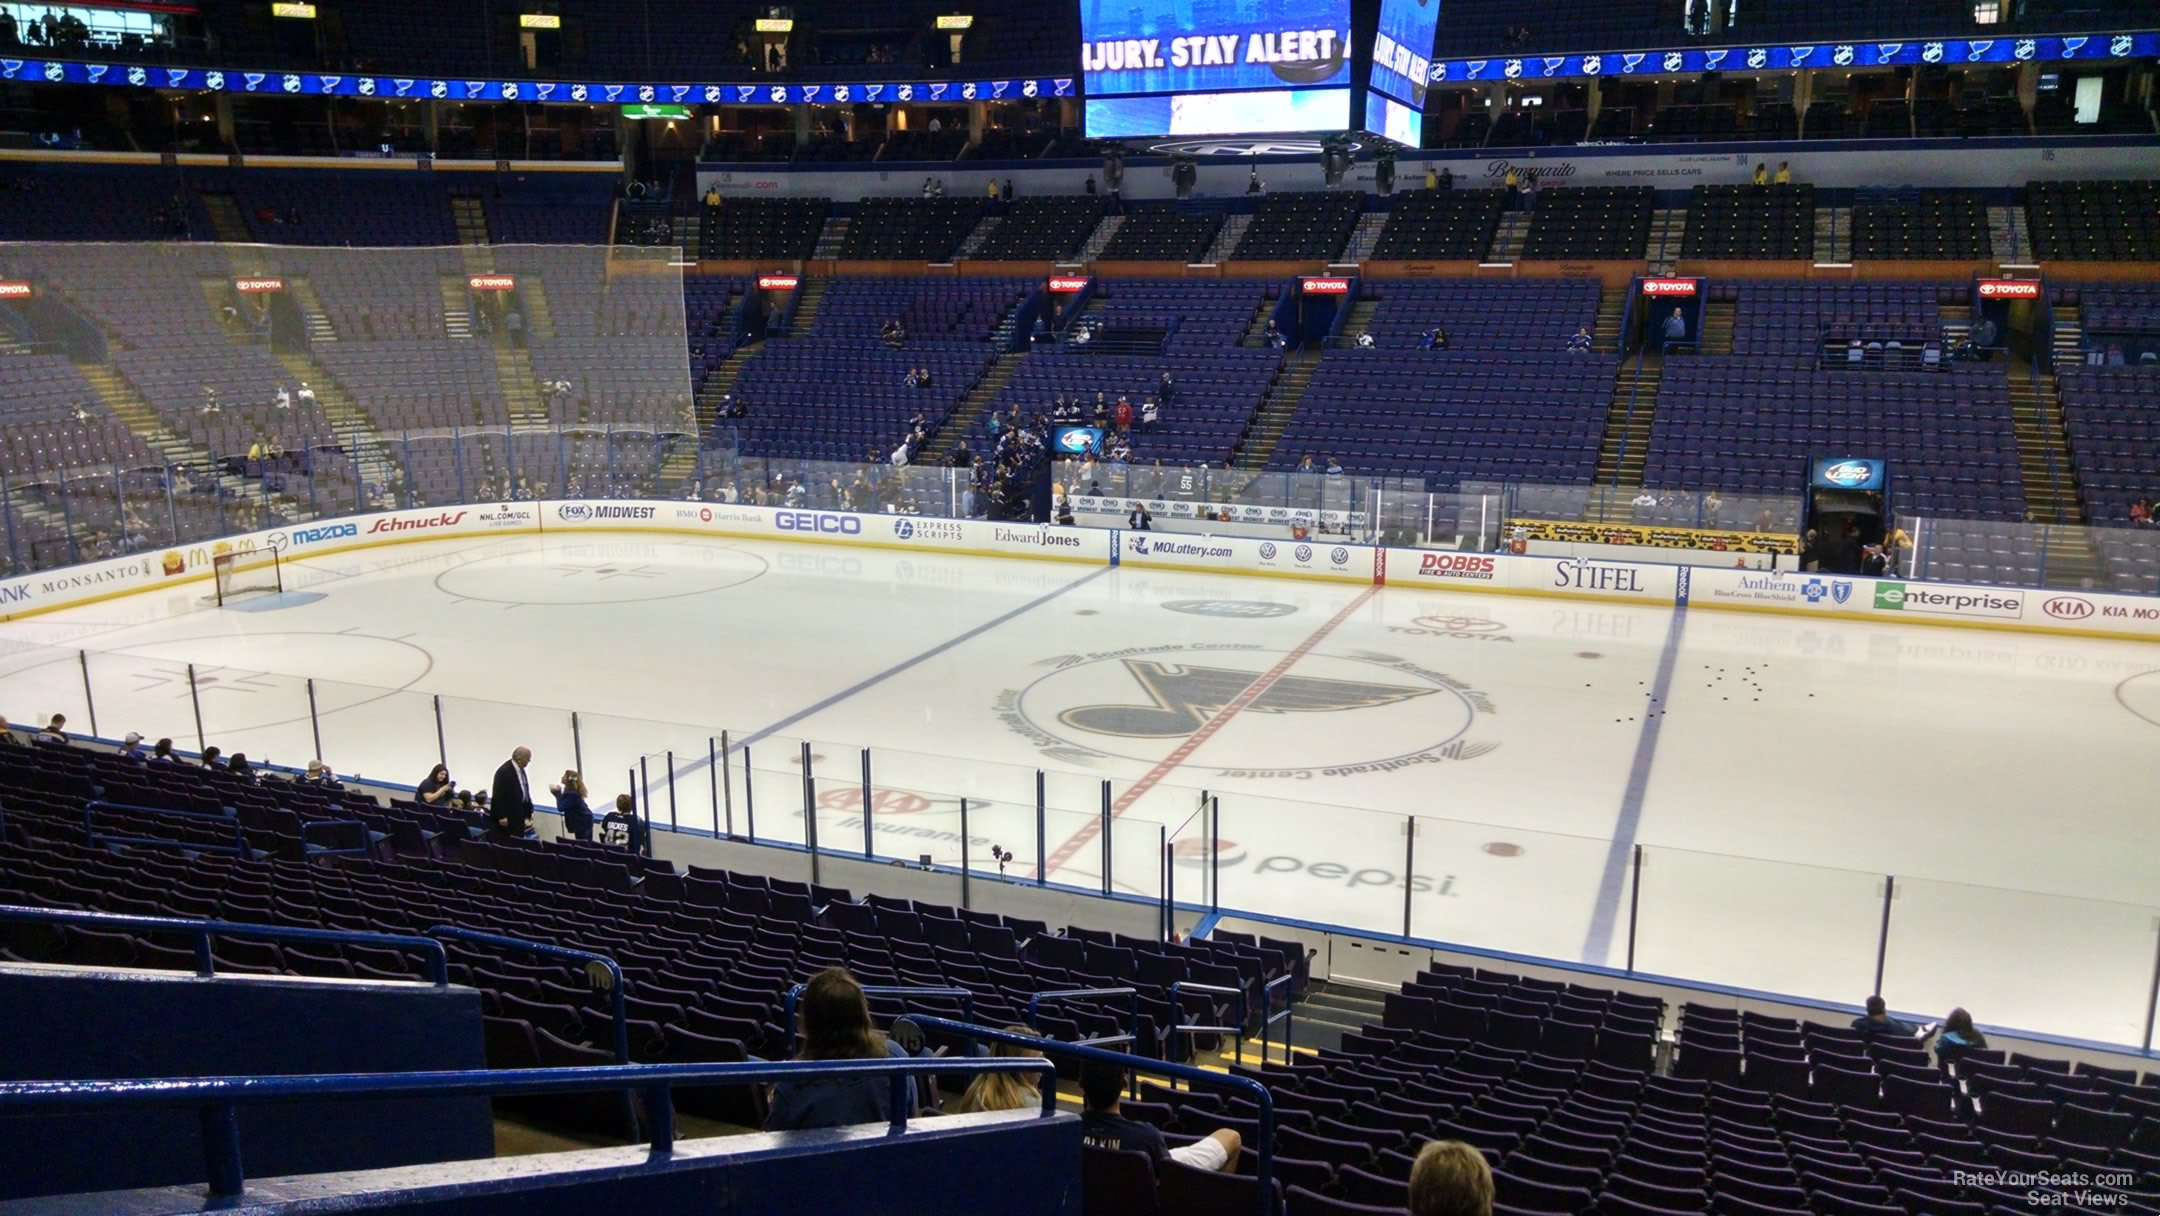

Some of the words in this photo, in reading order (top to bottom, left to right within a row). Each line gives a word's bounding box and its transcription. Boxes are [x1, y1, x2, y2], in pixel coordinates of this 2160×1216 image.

[1171, 35, 1239, 67] STAY
[1246, 29, 1337, 62] ALERT
[1658, 283, 1694, 291] TOYOTA
[1996, 285, 2036, 293] TOYOTA
[1180, 479, 1192, 490] 55
[479, 511, 531, 522] NHL.COM/GCL
[566, 506, 585, 515] FOX
[595, 506, 656, 518] MIDWEST
[677, 510, 697, 518] BMO
[715, 512, 740, 521] Harris
[742, 514, 763, 522] Bank
[775, 511, 861, 535] GEICO
[916, 521, 962, 531] EXPRESS
[916, 530, 962, 540] SCRIPTS
[1110, 530, 1118, 558] Reebok
[1153, 541, 1233, 558] MOLottery.com
[1376, 548, 1385, 577] Reebok
[1421, 554, 1495, 573] DOBBS
[42, 565, 139, 594] MONSANTO
[1555, 560, 1644, 593] STIFEL
[1679, 566, 1688, 598] Reebok
[1737, 576, 1796, 592] Anthem
[0, 583, 31, 604] NK
[1714, 589, 1752, 598] BlueCross
[1754, 592, 1796, 602] BlueShield
[1882, 588, 2020, 610] enterprise
[2052, 600, 2086, 616] KIA
[2102, 605, 2127, 617] KIA
[2133, 607, 2160, 620] MO
[1386, 625, 1515, 643] TOYOTA
[1087, 644, 1184, 660] Scottrade
[1190, 642, 1265, 650] Center
[1322, 752, 1442, 777] Scottrade
[604, 829, 630, 846] 42
[836, 816, 991, 847] Insurance
[1253, 855, 1459, 897] pepsi
